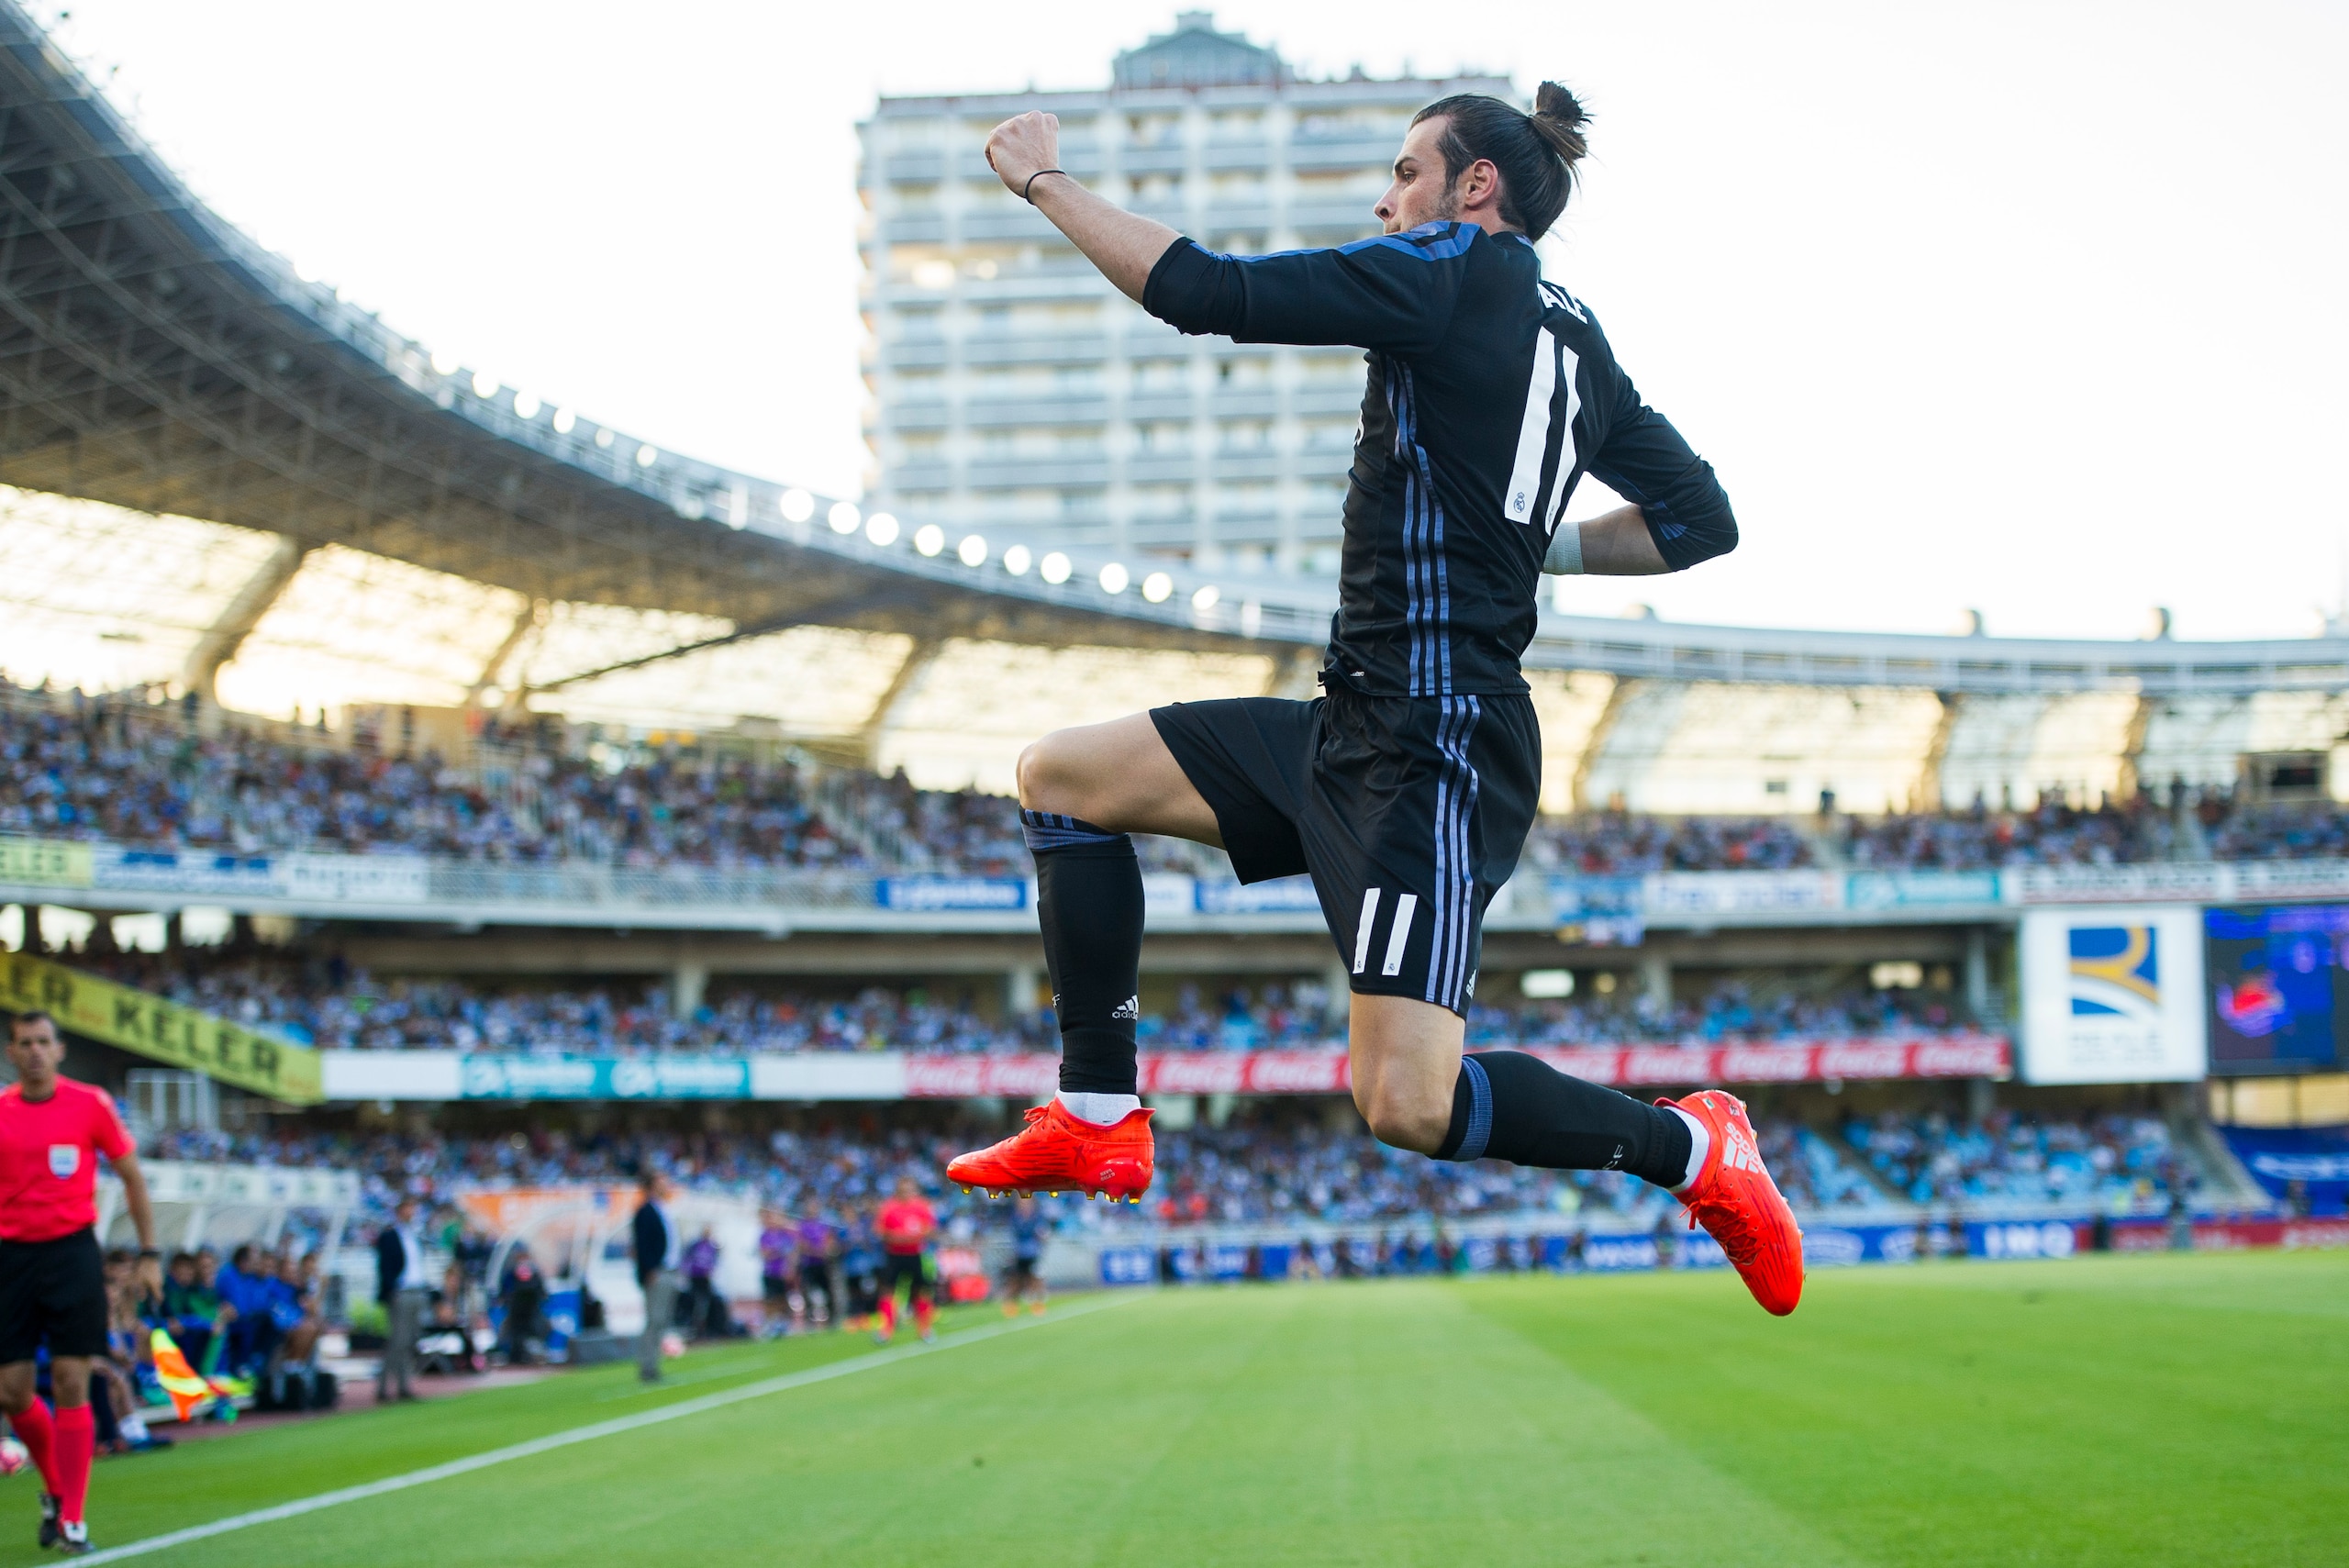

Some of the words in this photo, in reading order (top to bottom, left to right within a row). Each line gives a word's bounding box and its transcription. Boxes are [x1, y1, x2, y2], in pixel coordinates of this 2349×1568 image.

[1538, 283, 1588, 325] ALE
[1504, 326, 1582, 537] 11
[1353, 887, 1419, 976] 11
[111, 995, 282, 1081] KELER
[1111, 1010, 1139, 1020] adid
